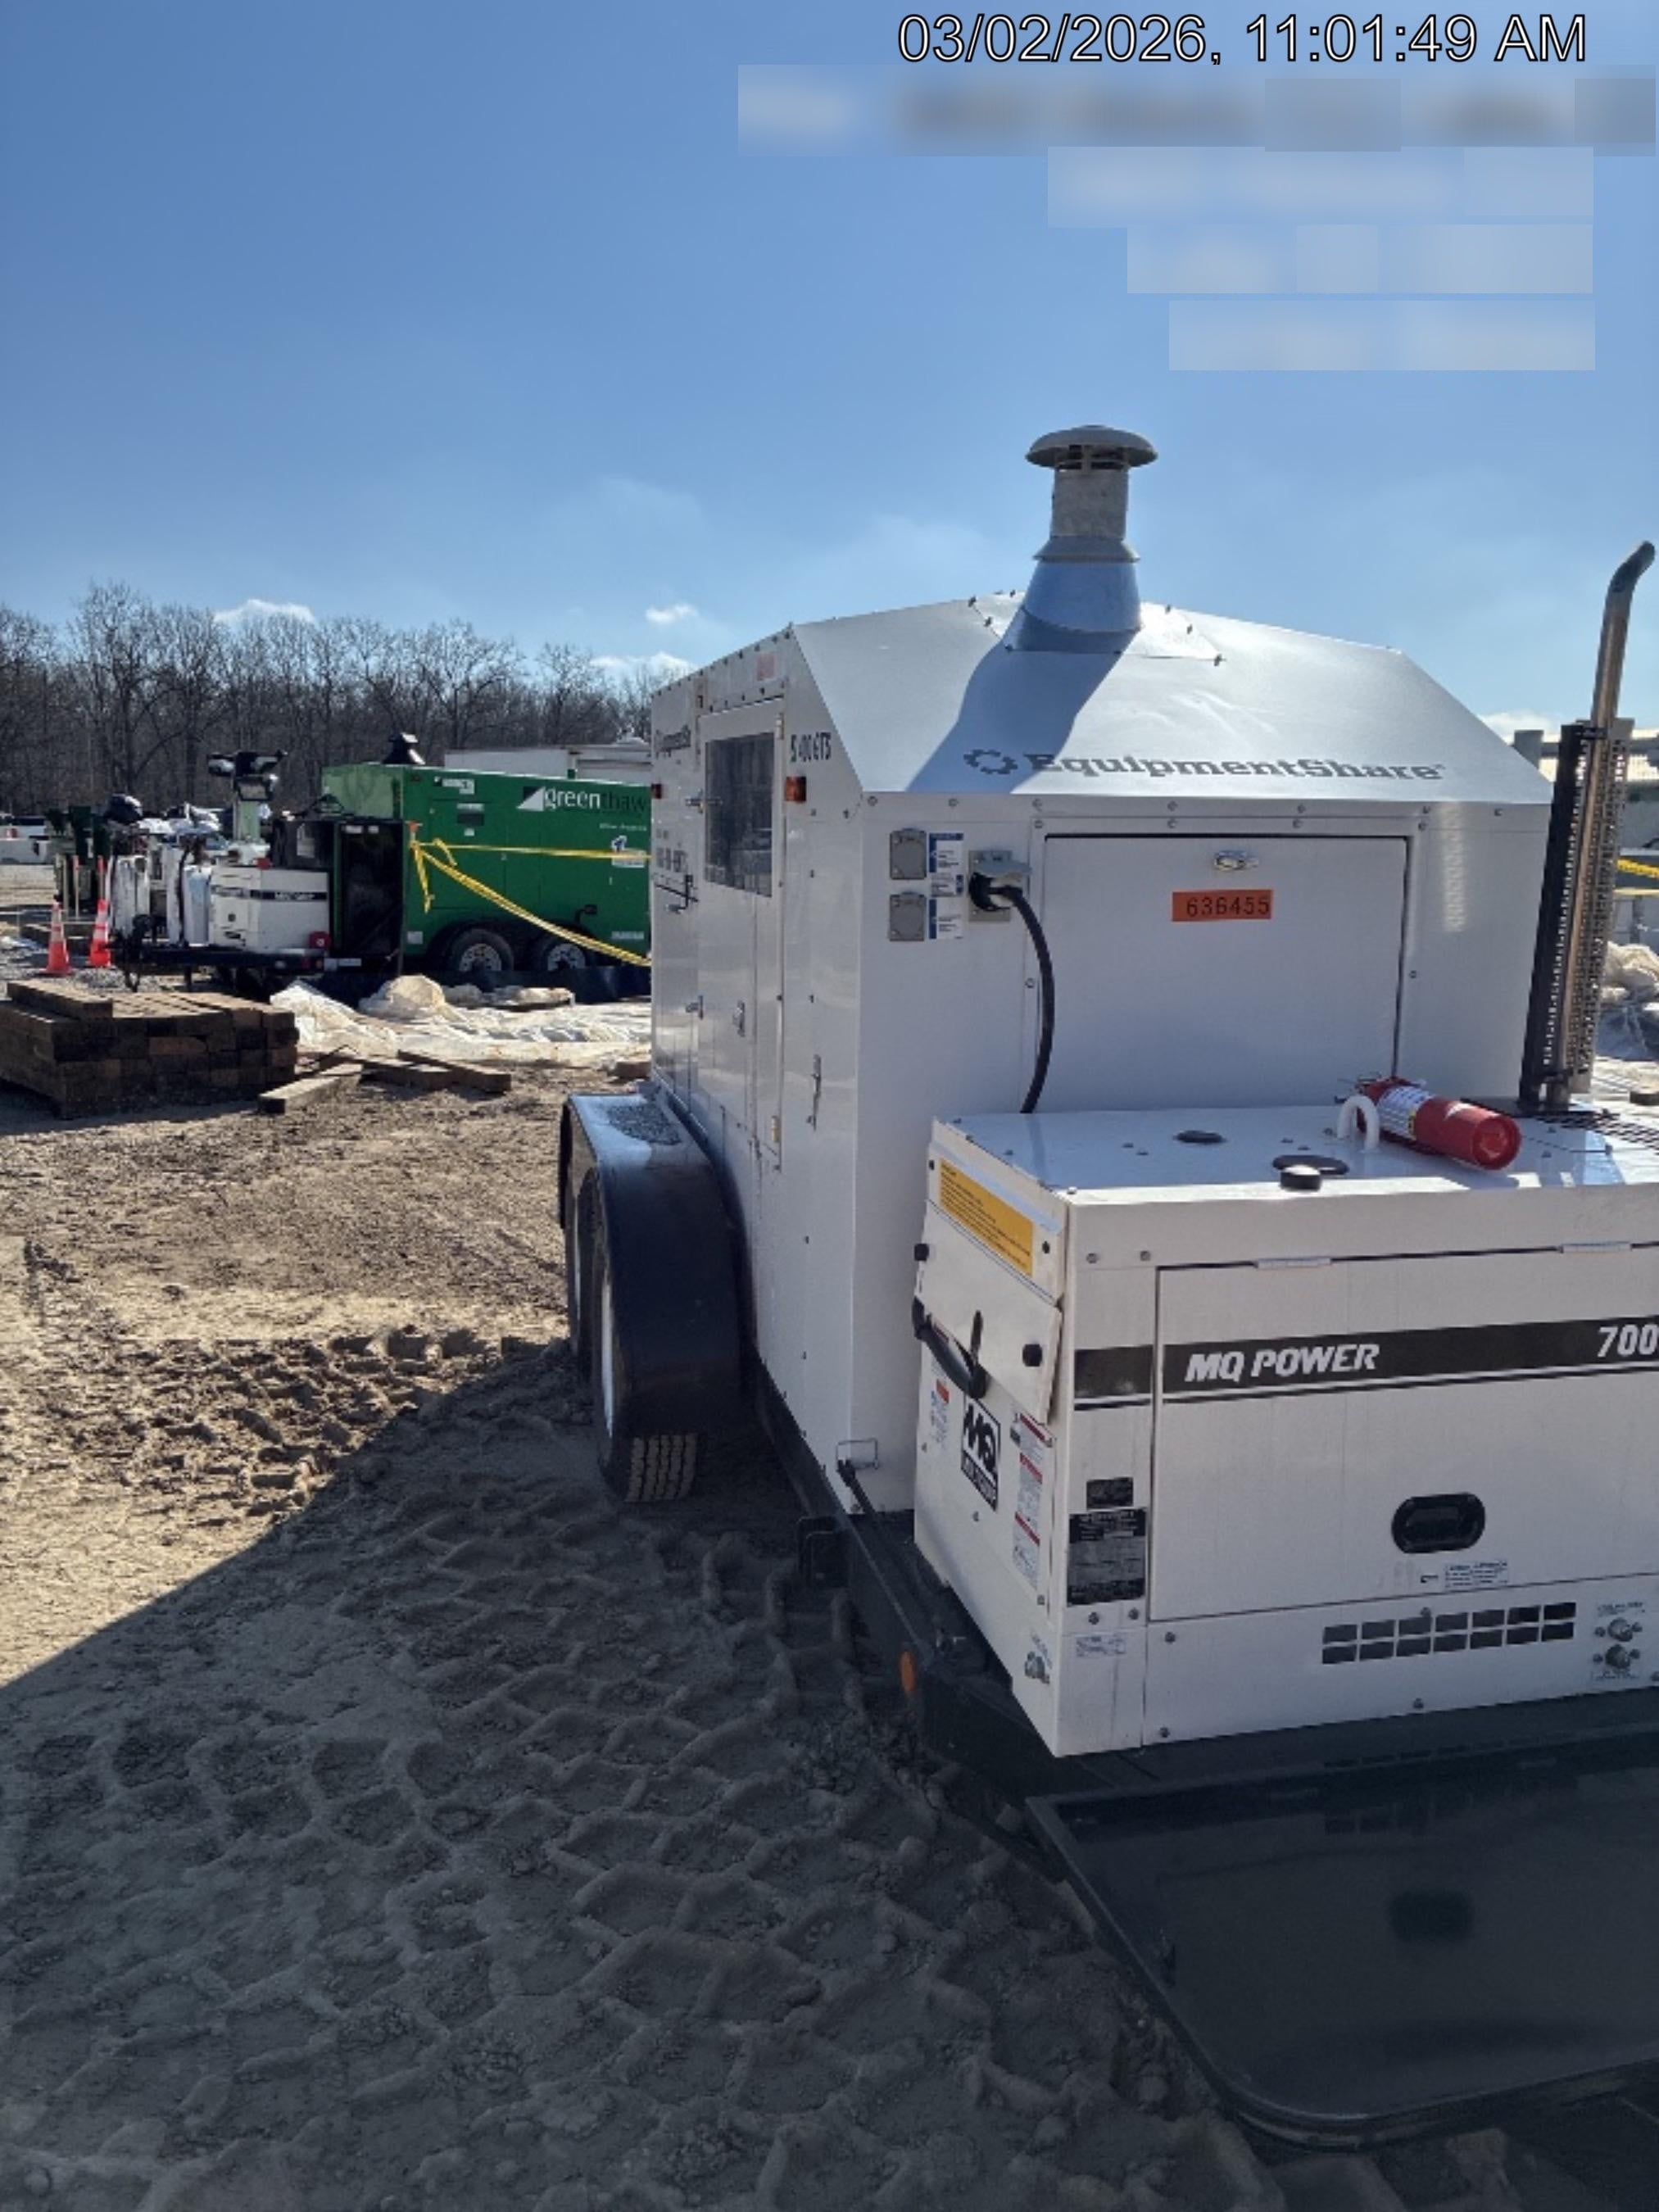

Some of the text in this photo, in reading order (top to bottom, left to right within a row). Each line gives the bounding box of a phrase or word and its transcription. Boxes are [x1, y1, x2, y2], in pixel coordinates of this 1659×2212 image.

[1024, 754, 1442, 779] EquipmentShare
[1186, 896, 1270, 918] 636455
[1597, 1324, 1659, 1358] 700
[1185, 1344, 1380, 1382] MQ POWER
